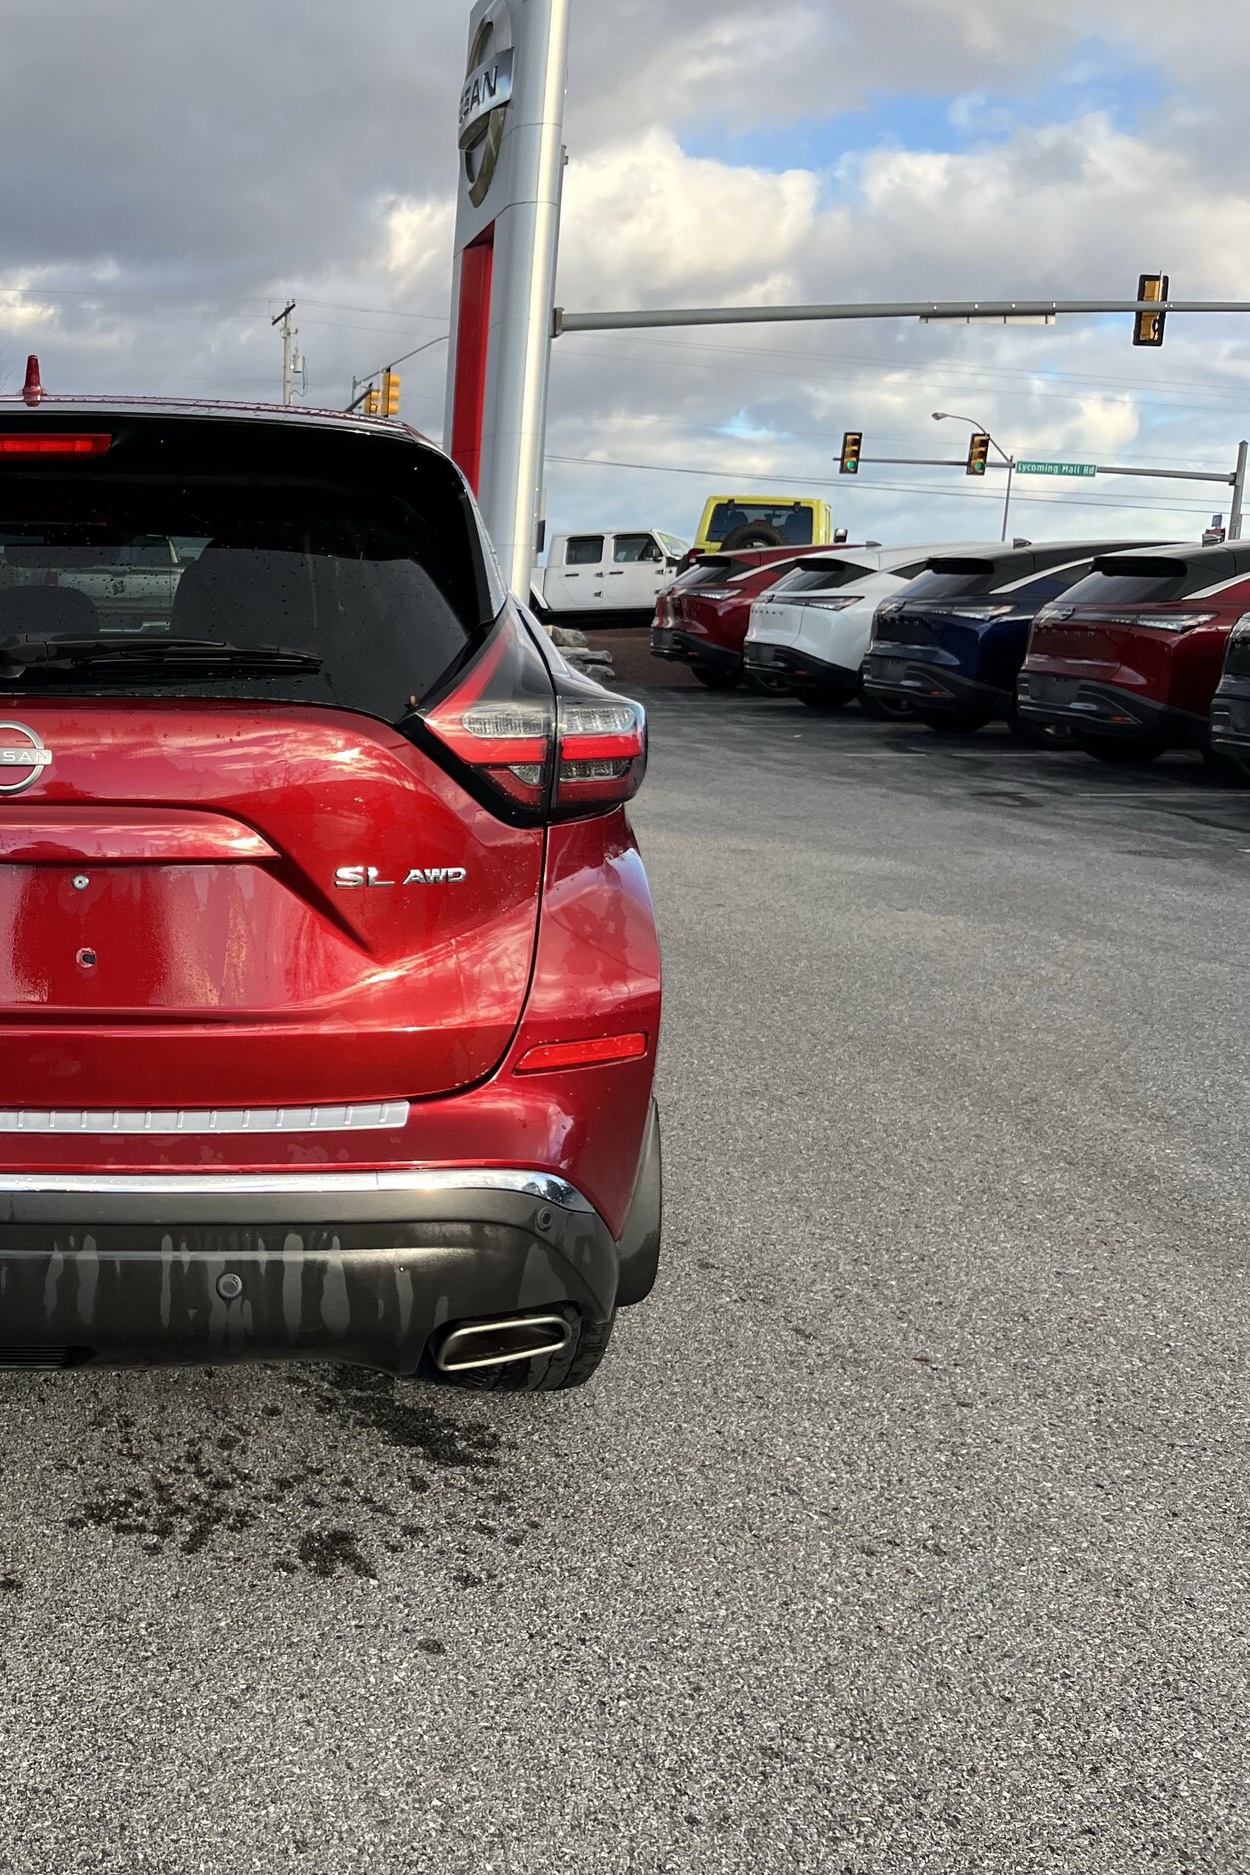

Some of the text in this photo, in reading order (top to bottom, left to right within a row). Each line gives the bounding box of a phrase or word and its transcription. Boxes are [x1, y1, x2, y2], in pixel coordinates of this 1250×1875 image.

[1018, 462, 1095, 475] Lycoming Mall Rd
[335, 866, 467, 890] SL AWD
